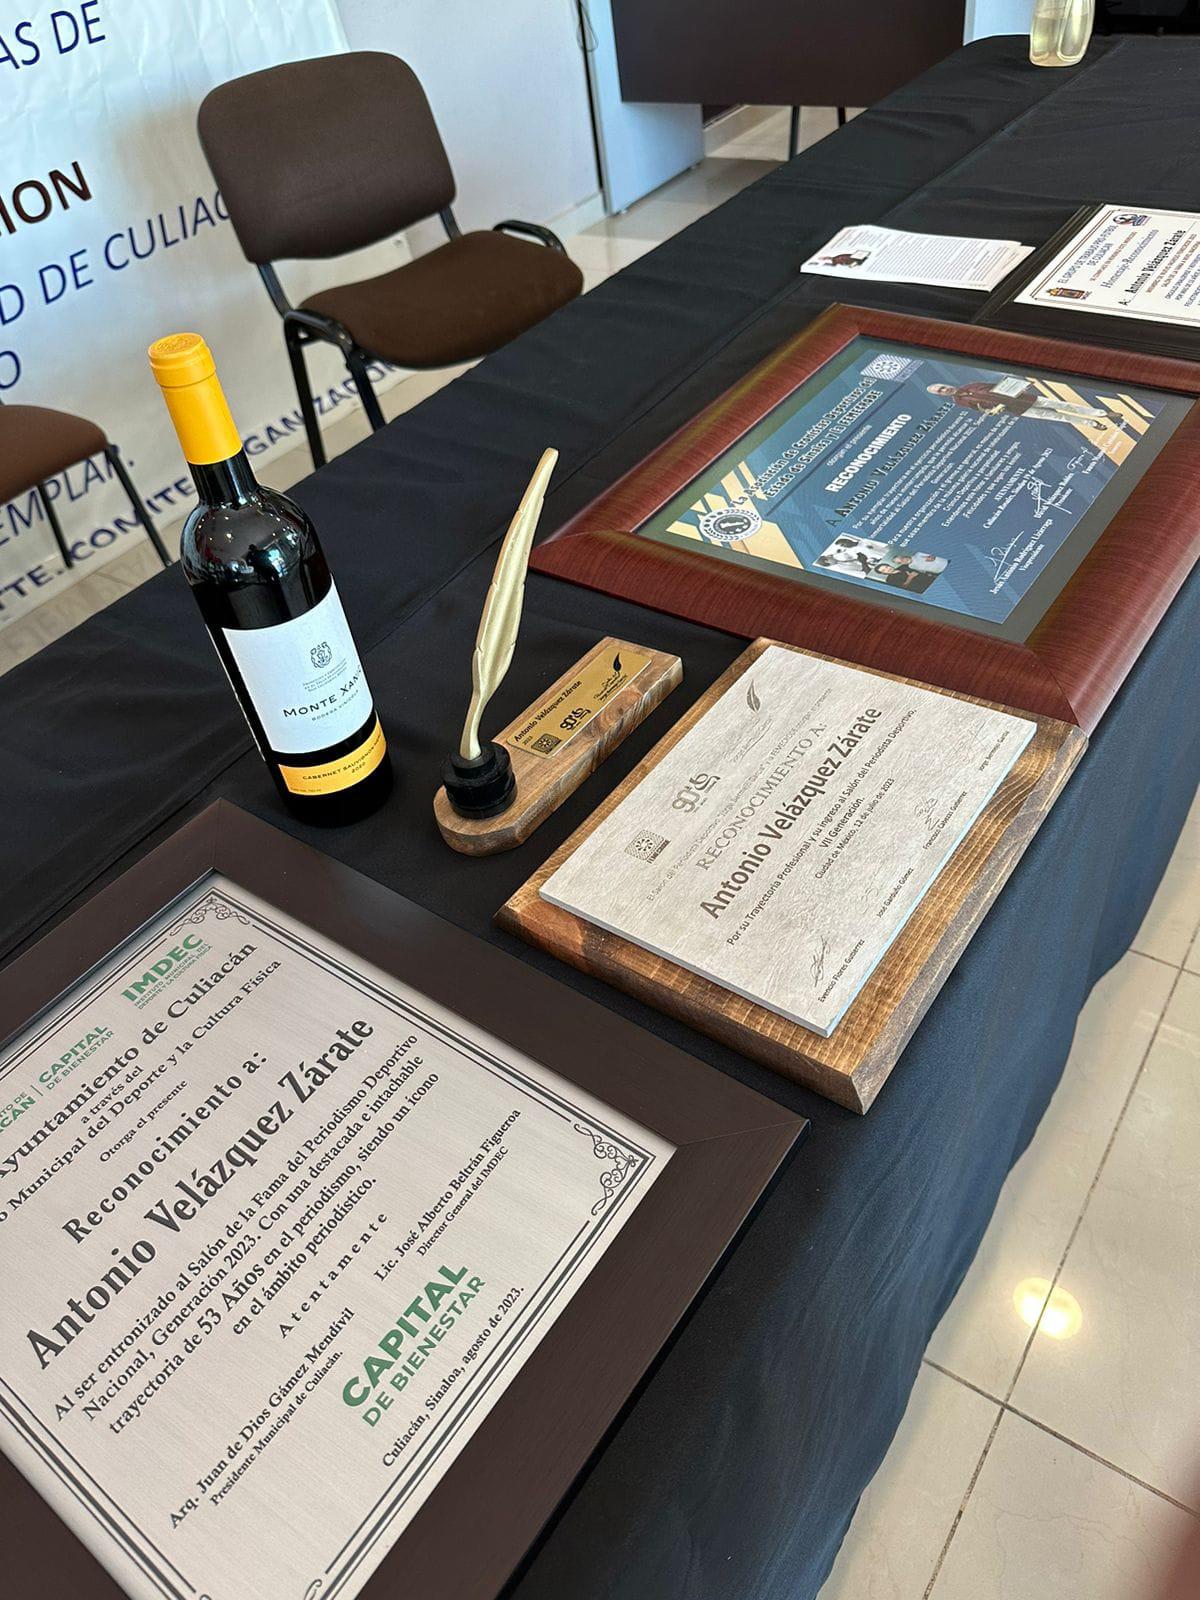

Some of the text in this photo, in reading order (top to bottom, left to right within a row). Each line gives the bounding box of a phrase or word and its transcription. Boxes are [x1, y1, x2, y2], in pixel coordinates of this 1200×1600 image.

[51, 0, 107, 55] DE
[38, 249, 95, 306] DE
[738, 457, 792, 497] Asociación
[779, 447, 802, 460] de
[784, 461, 809, 475] de
[795, 437, 835, 465] Sinaloa
[822, 412, 916, 493] RECONOCIMIENTO
[759, 471, 798, 498] Estado
[283, 695, 338, 718] MONTE
[513, 720, 538, 742] Antonio
[534, 696, 565, 721] Velázquez
[302, 769, 342, 781] CABERNET
[856, 767, 869, 779] del
[864, 738, 893, 768] Periodista
[694, 738, 813, 871] RECONOCIMIENTO
[808, 722, 827, 738] A:
[699, 843, 772, 920] Antonio
[757, 756, 842, 840] Velázquez
[826, 708, 882, 758] Zárate
[816, 803, 841, 828] ingreso
[837, 795, 847, 804] al
[841, 778, 861, 797] Salón
[812, 827, 823, 837] su
[818, 797, 865, 848] VII Generación.
[776, 840, 812, 881] Profesional
[738, 920, 750, 931] su
[744, 880, 782, 920] Trayectoria
[120, 933, 203, 1002] IMDEC
[726, 930, 741, 946] Por
[141, 1021, 168, 1045] de
[167, 944, 258, 1018] Culiacán
[38, 1026, 108, 1083] CAPITAL
[45, 1030, 115, 1090] DE BIENESTAR
[6, 1136, 87, 1211] Municipal
[87, 1114, 111, 1139] del
[107, 1064, 168, 1117] Deporte
[166, 1053, 177, 1066] y
[174, 1041, 194, 1055] la
[191, 995, 244, 1039] Cultura
[239, 961, 282, 995] Física
[80, 1065, 144, 1124] a través del
[61, 1052, 267, 1244] Reconocimiento a:
[99, 1080, 188, 1162] Otorga el presente
[26, 1240, 156, 1370] Antonio
[143, 1100, 294, 1232] Velázquez
[277, 1020, 374, 1104] Zárate
[373, 1110, 521, 1281] Lic. José Alberto Beltrán Figueroa
[416, 1145, 509, 1256] Director General del IMDEC
[55, 1035, 418, 1422] Al ser entronizado al Salón de la Fama del Periodismo Deportivo
[81, 1056, 423, 1422] Nacional, Generación 2023. Con una destacada e intachable
[109, 1073, 439, 1434] trayectoria de 53 Años en el periodismo, siendo un ícono
[232, 1178, 376, 1335] en el ámbito periodístico.
[342, 1264, 469, 1407] CAPITAL
[361, 1276, 486, 1427] DE BIENESTAR
[382, 1287, 524, 1467] Culiacán, Sinaloa, agosto de 2023.
[170, 1307, 355, 1529] Arq. Juan de Dios Gámez Mendívil
[209, 1351, 343, 1506] Presidente Municipal de Culiacán.
